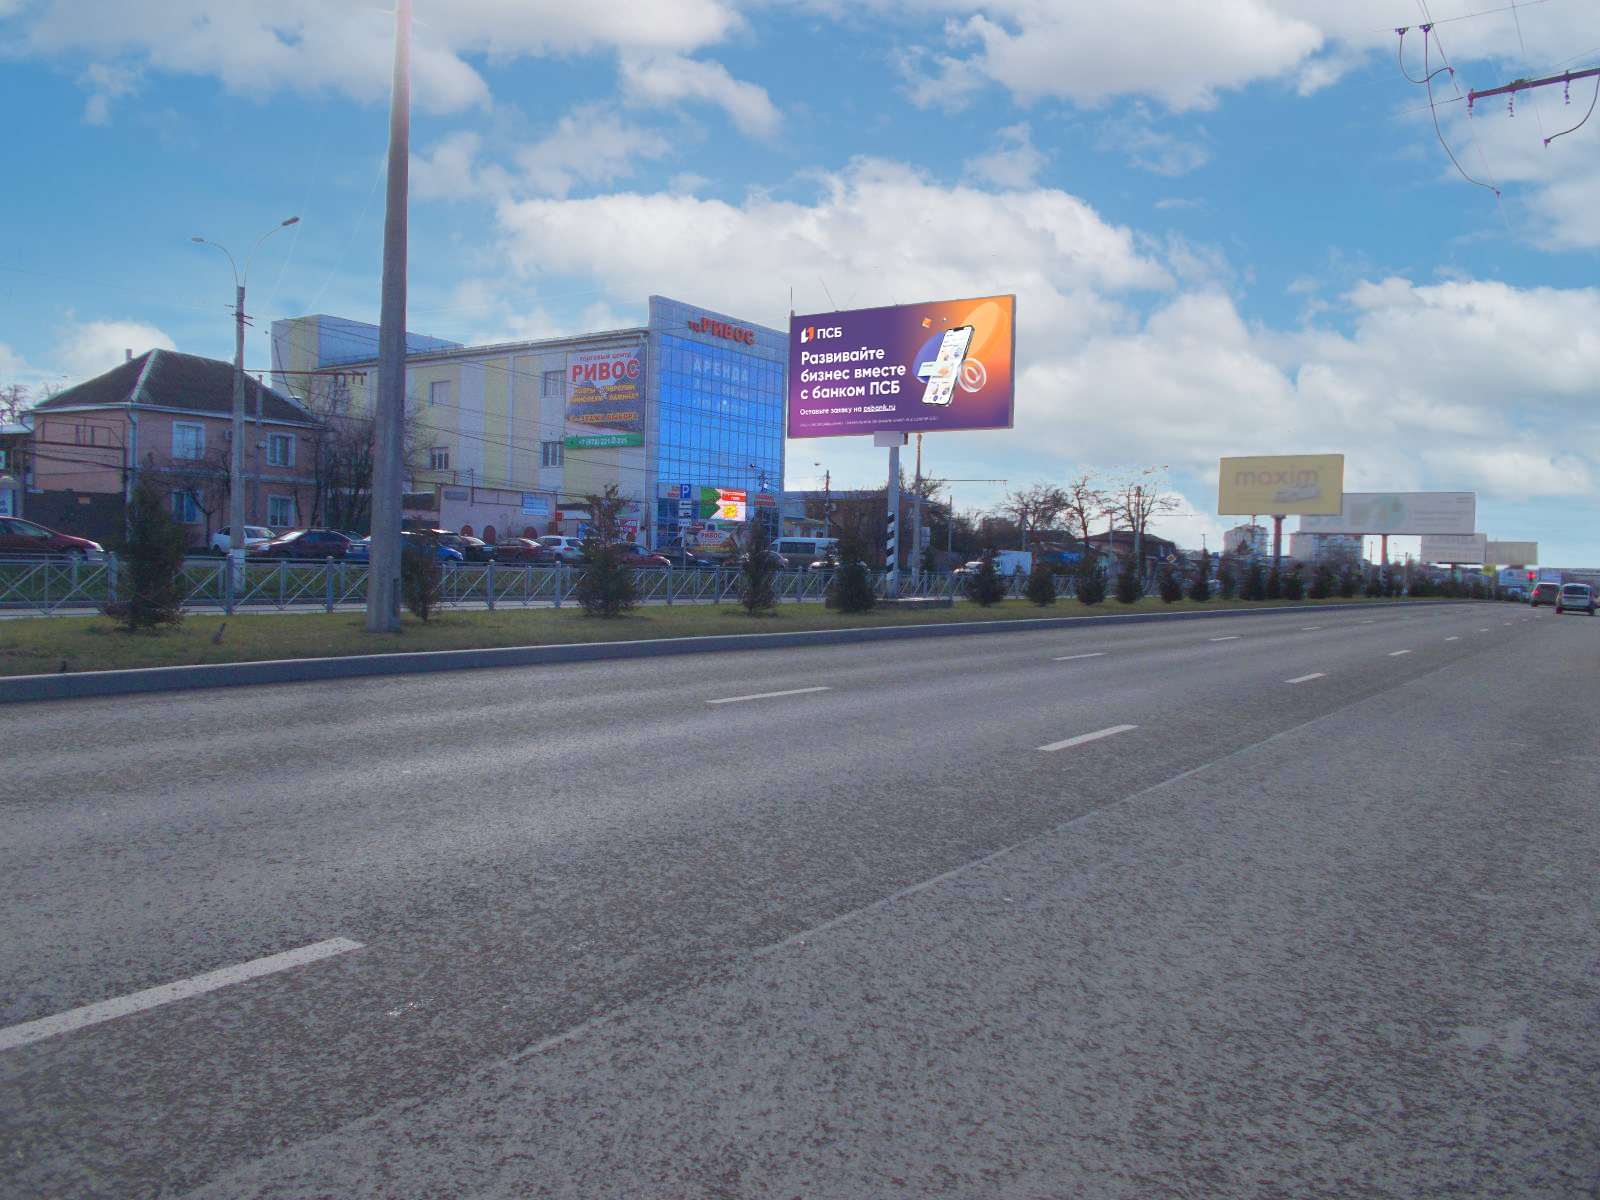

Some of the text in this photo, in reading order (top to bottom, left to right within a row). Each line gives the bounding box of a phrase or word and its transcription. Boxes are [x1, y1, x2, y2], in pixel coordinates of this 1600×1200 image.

[700, 316, 754, 345] РИВОС
[817, 327, 842, 340] ПСБ
[579, 352, 632, 363] торговый центр
[801, 347, 885, 365] Развивайте
[572, 358, 641, 383] РИВОС
[693, 357, 749, 385] АРЕНДА
[800, 368, 850, 383] бизнес
[854, 364, 906, 379] вместе
[800, 381, 900, 400] с банком ПСБ
[800, 408, 829, 416] Оставьте
[830, 407, 852, 415] заявку
[863, 404, 896, 413] psbank.ru
[1235, 465, 1319, 486] maxim
[1428, 536, 1477, 545] АРЕНДА
